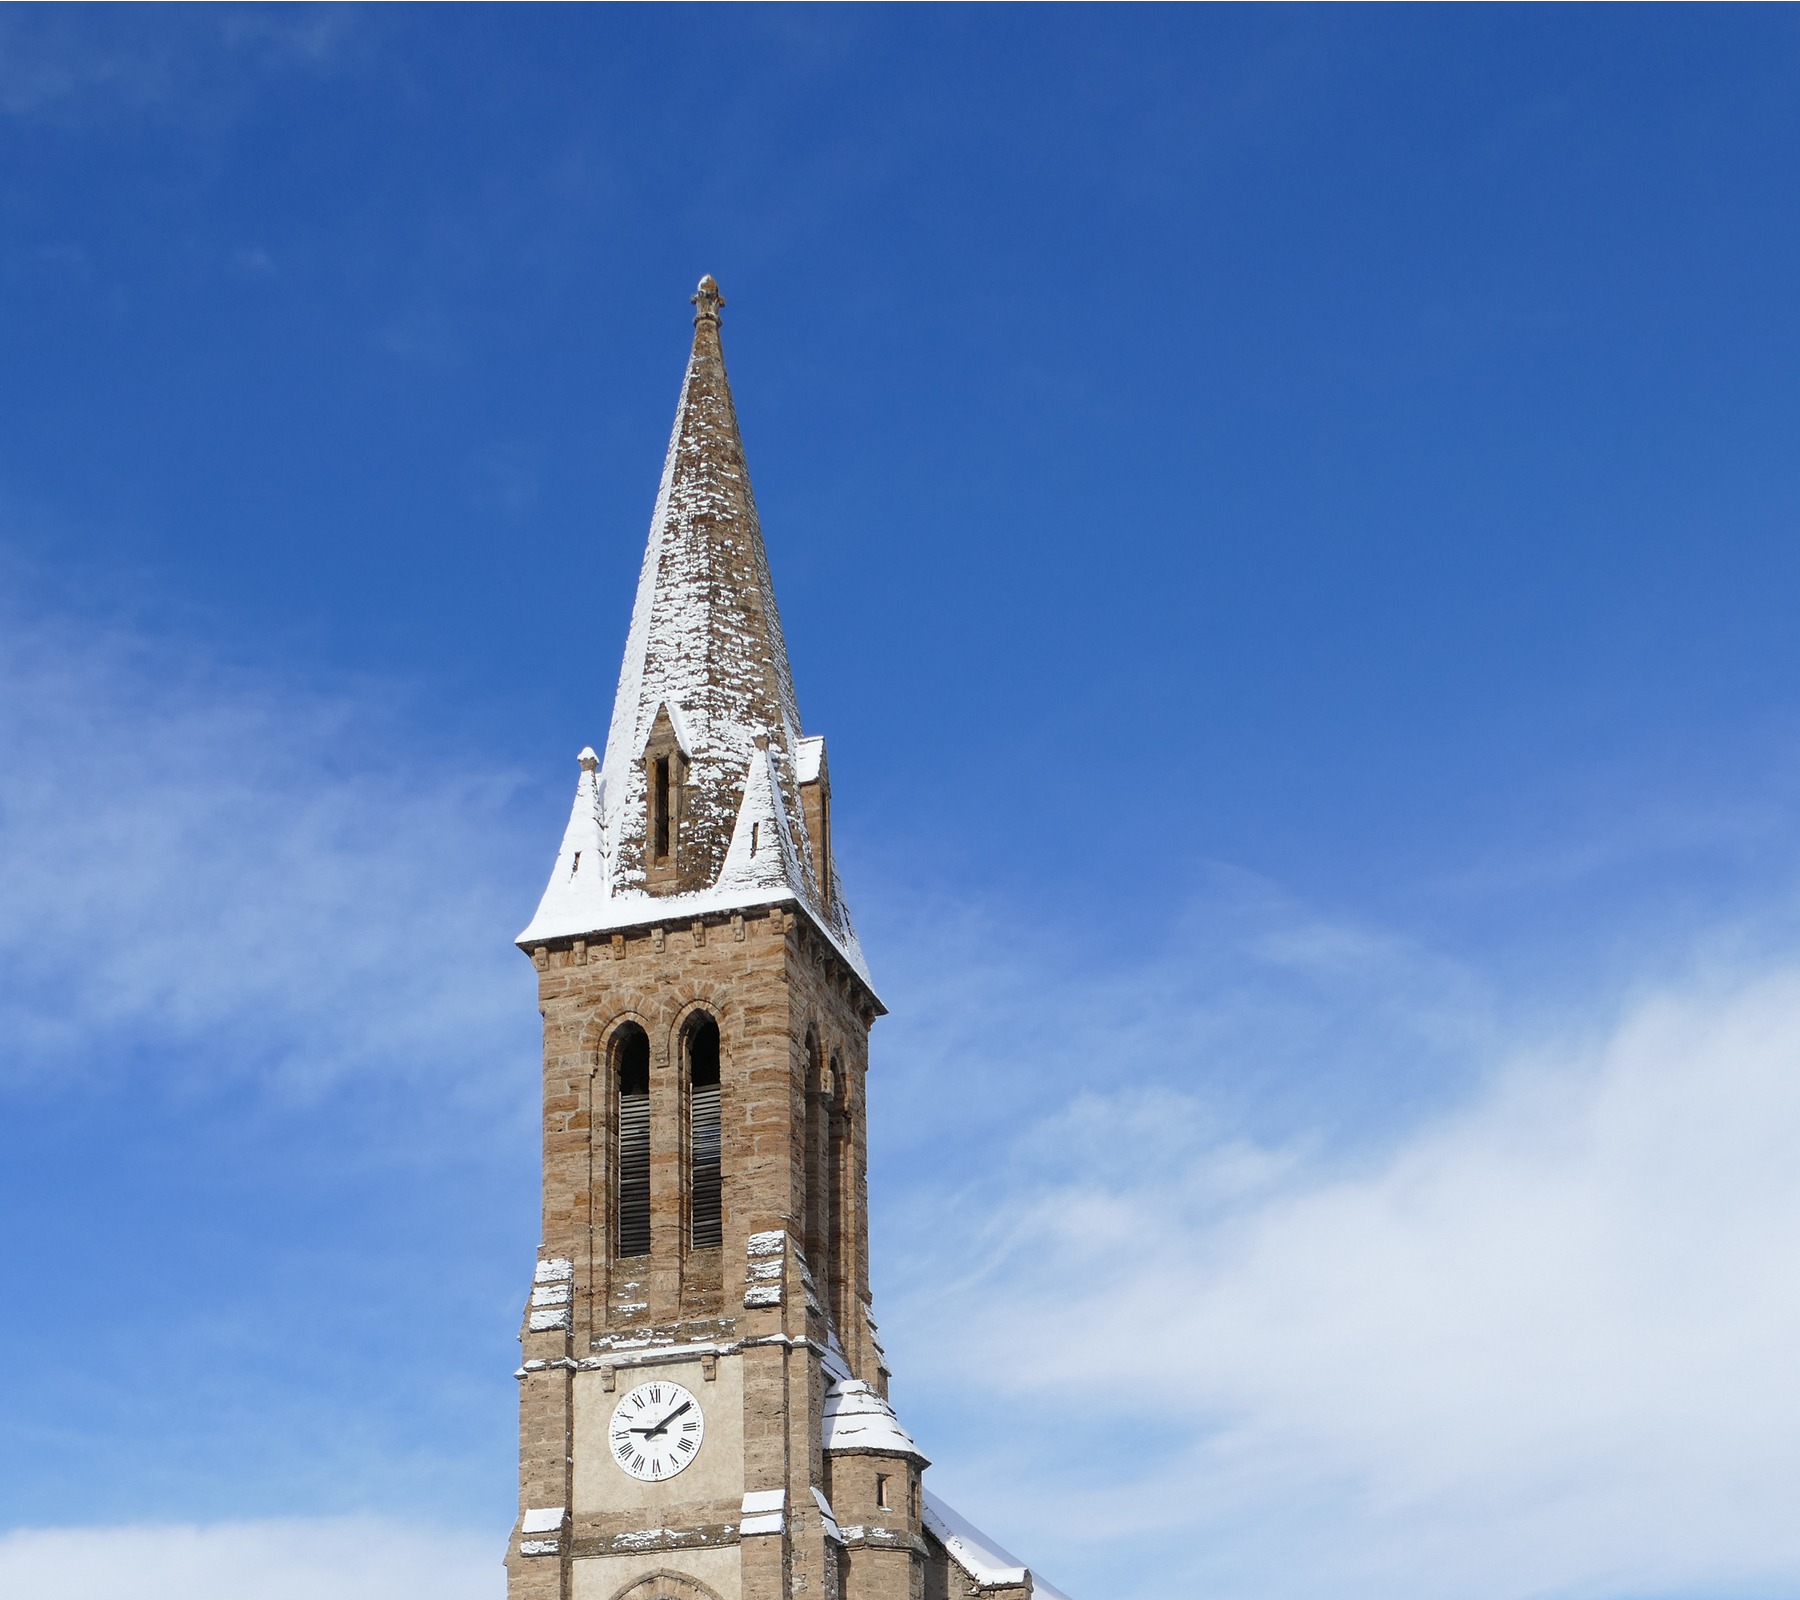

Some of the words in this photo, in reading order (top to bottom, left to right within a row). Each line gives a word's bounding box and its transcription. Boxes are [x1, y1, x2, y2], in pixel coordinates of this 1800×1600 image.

[632, 1394, 645, 1411] XI
[649, 1388, 661, 1404] XII
[669, 1392, 676, 1405] I
[620, 1412, 633, 1422] X
[683, 1422, 696, 1431] III
[616, 1430, 630, 1439] IX
[618, 1442, 635, 1460] VIII
[632, 1454, 645, 1471] VII
[652, 1459, 661, 1473] VI
[669, 1454, 678, 1466] V
